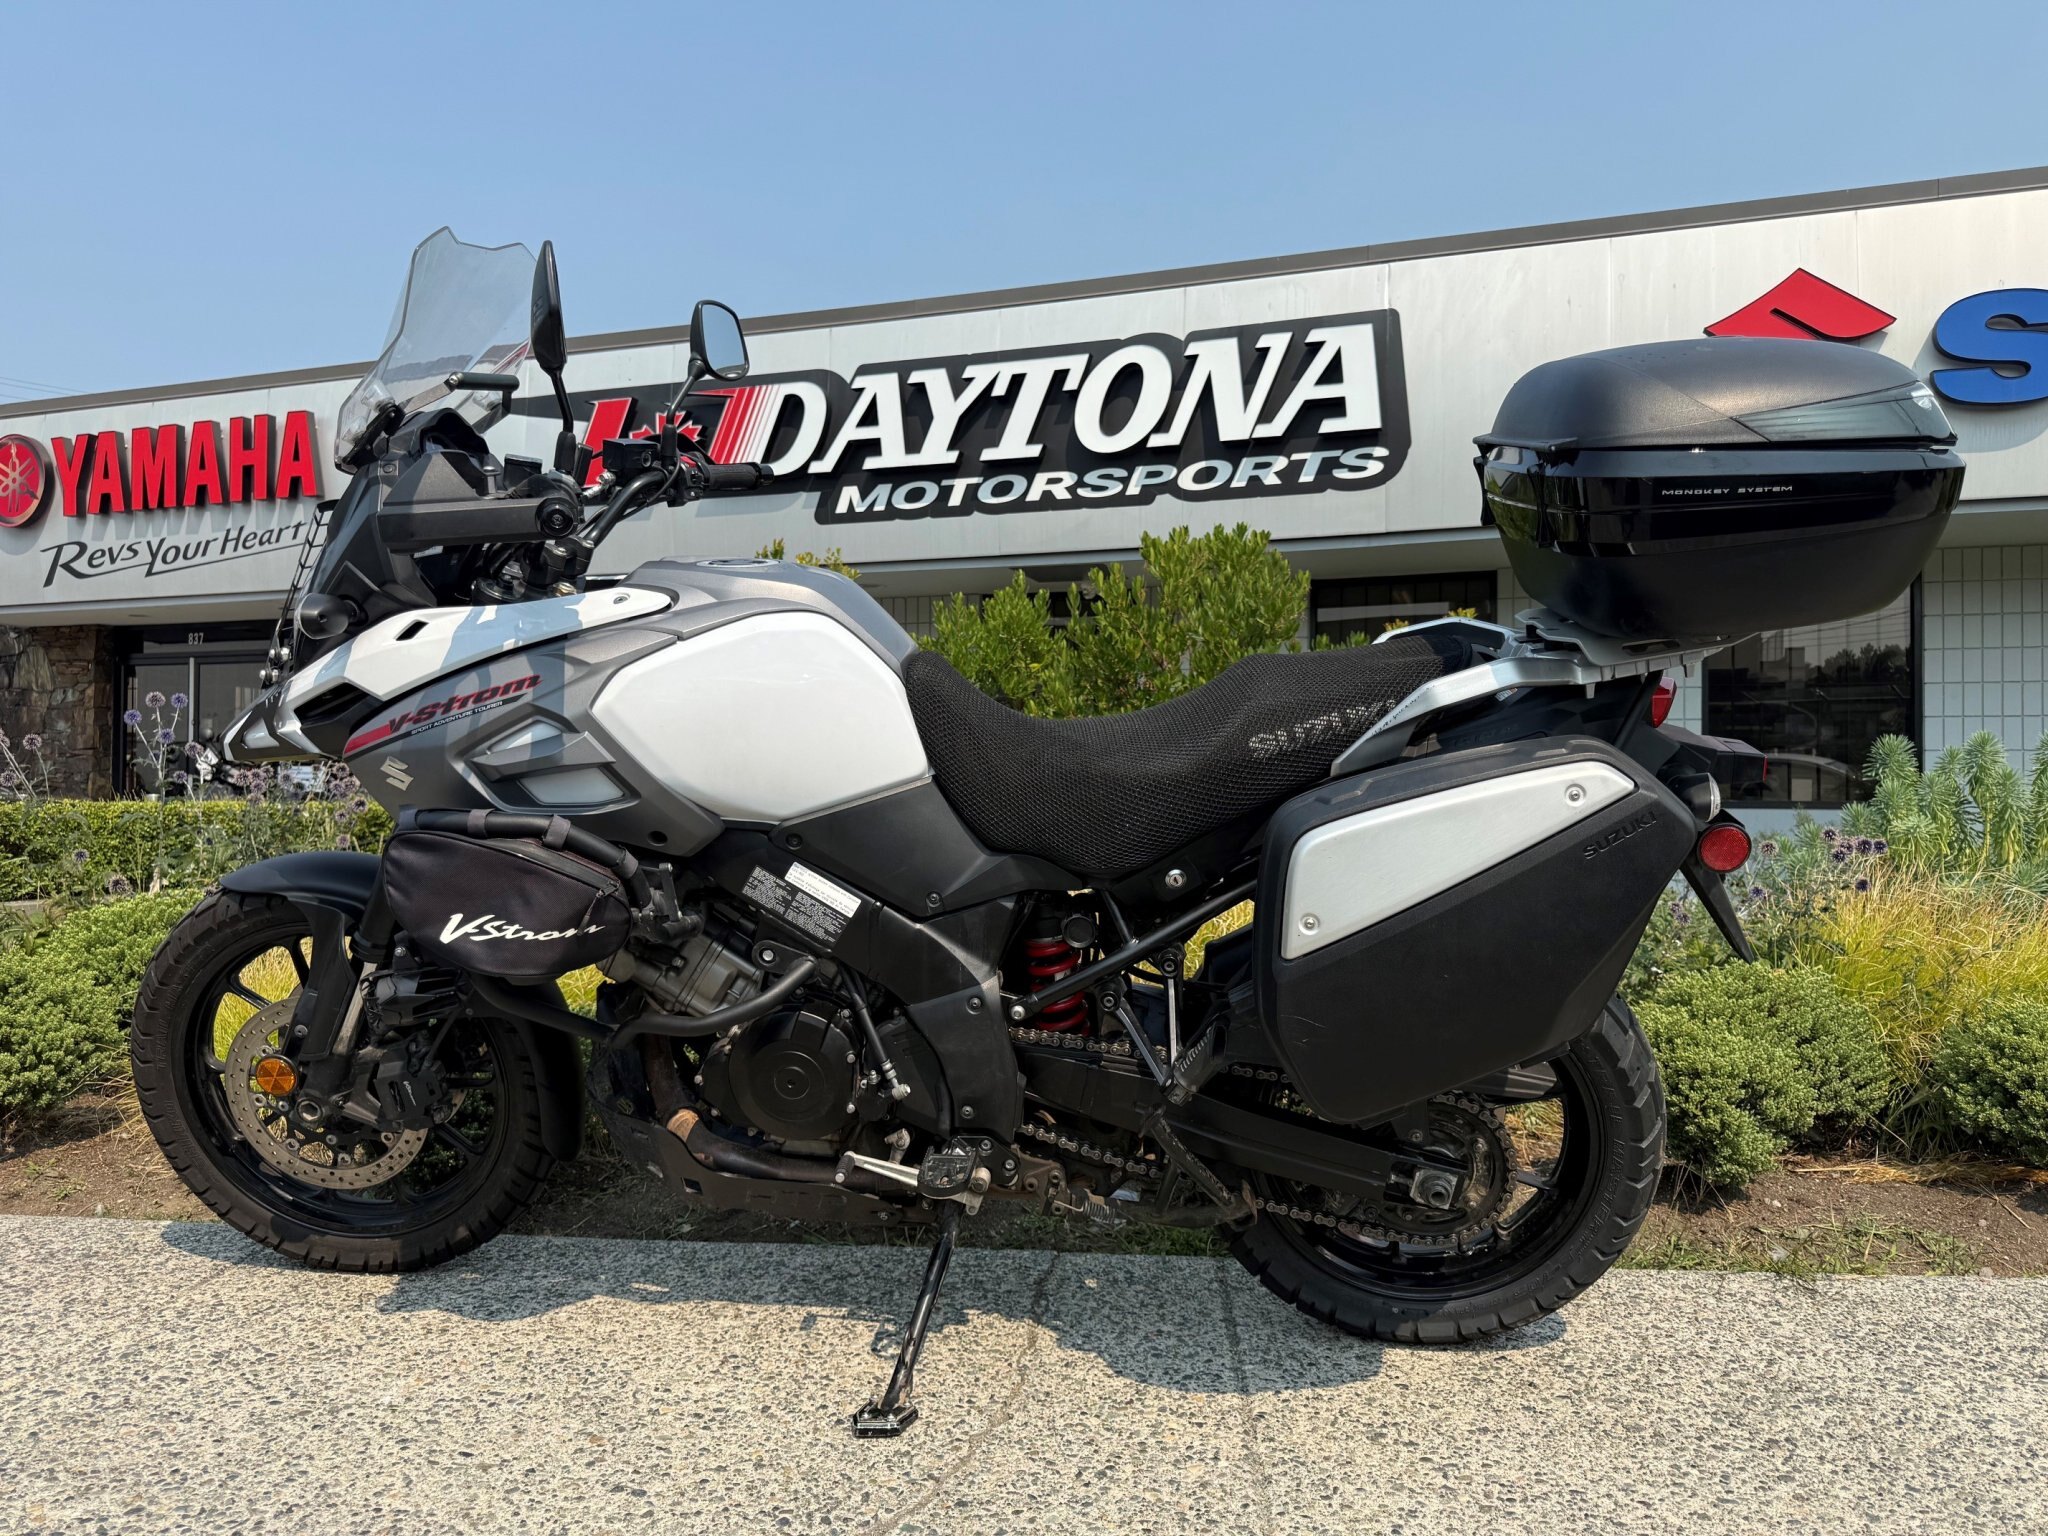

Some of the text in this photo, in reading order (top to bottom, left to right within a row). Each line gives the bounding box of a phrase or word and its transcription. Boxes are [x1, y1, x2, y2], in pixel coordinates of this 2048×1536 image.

[1930, 288, 2048, 405] S
[712, 322, 1382, 477] DAYTONA
[51, 410, 321, 517] YAMAHA
[835, 446, 1390, 515] MOTORSPORTS
[1661, 485, 1793, 496] MONOKEY SYSTEM
[219, 520, 308, 556] Heart
[188, 632, 204, 645] 837
[411, 701, 503, 735] SPORT ADVENTURE TOURER
[1583, 811, 1657, 860] SUZUKI
